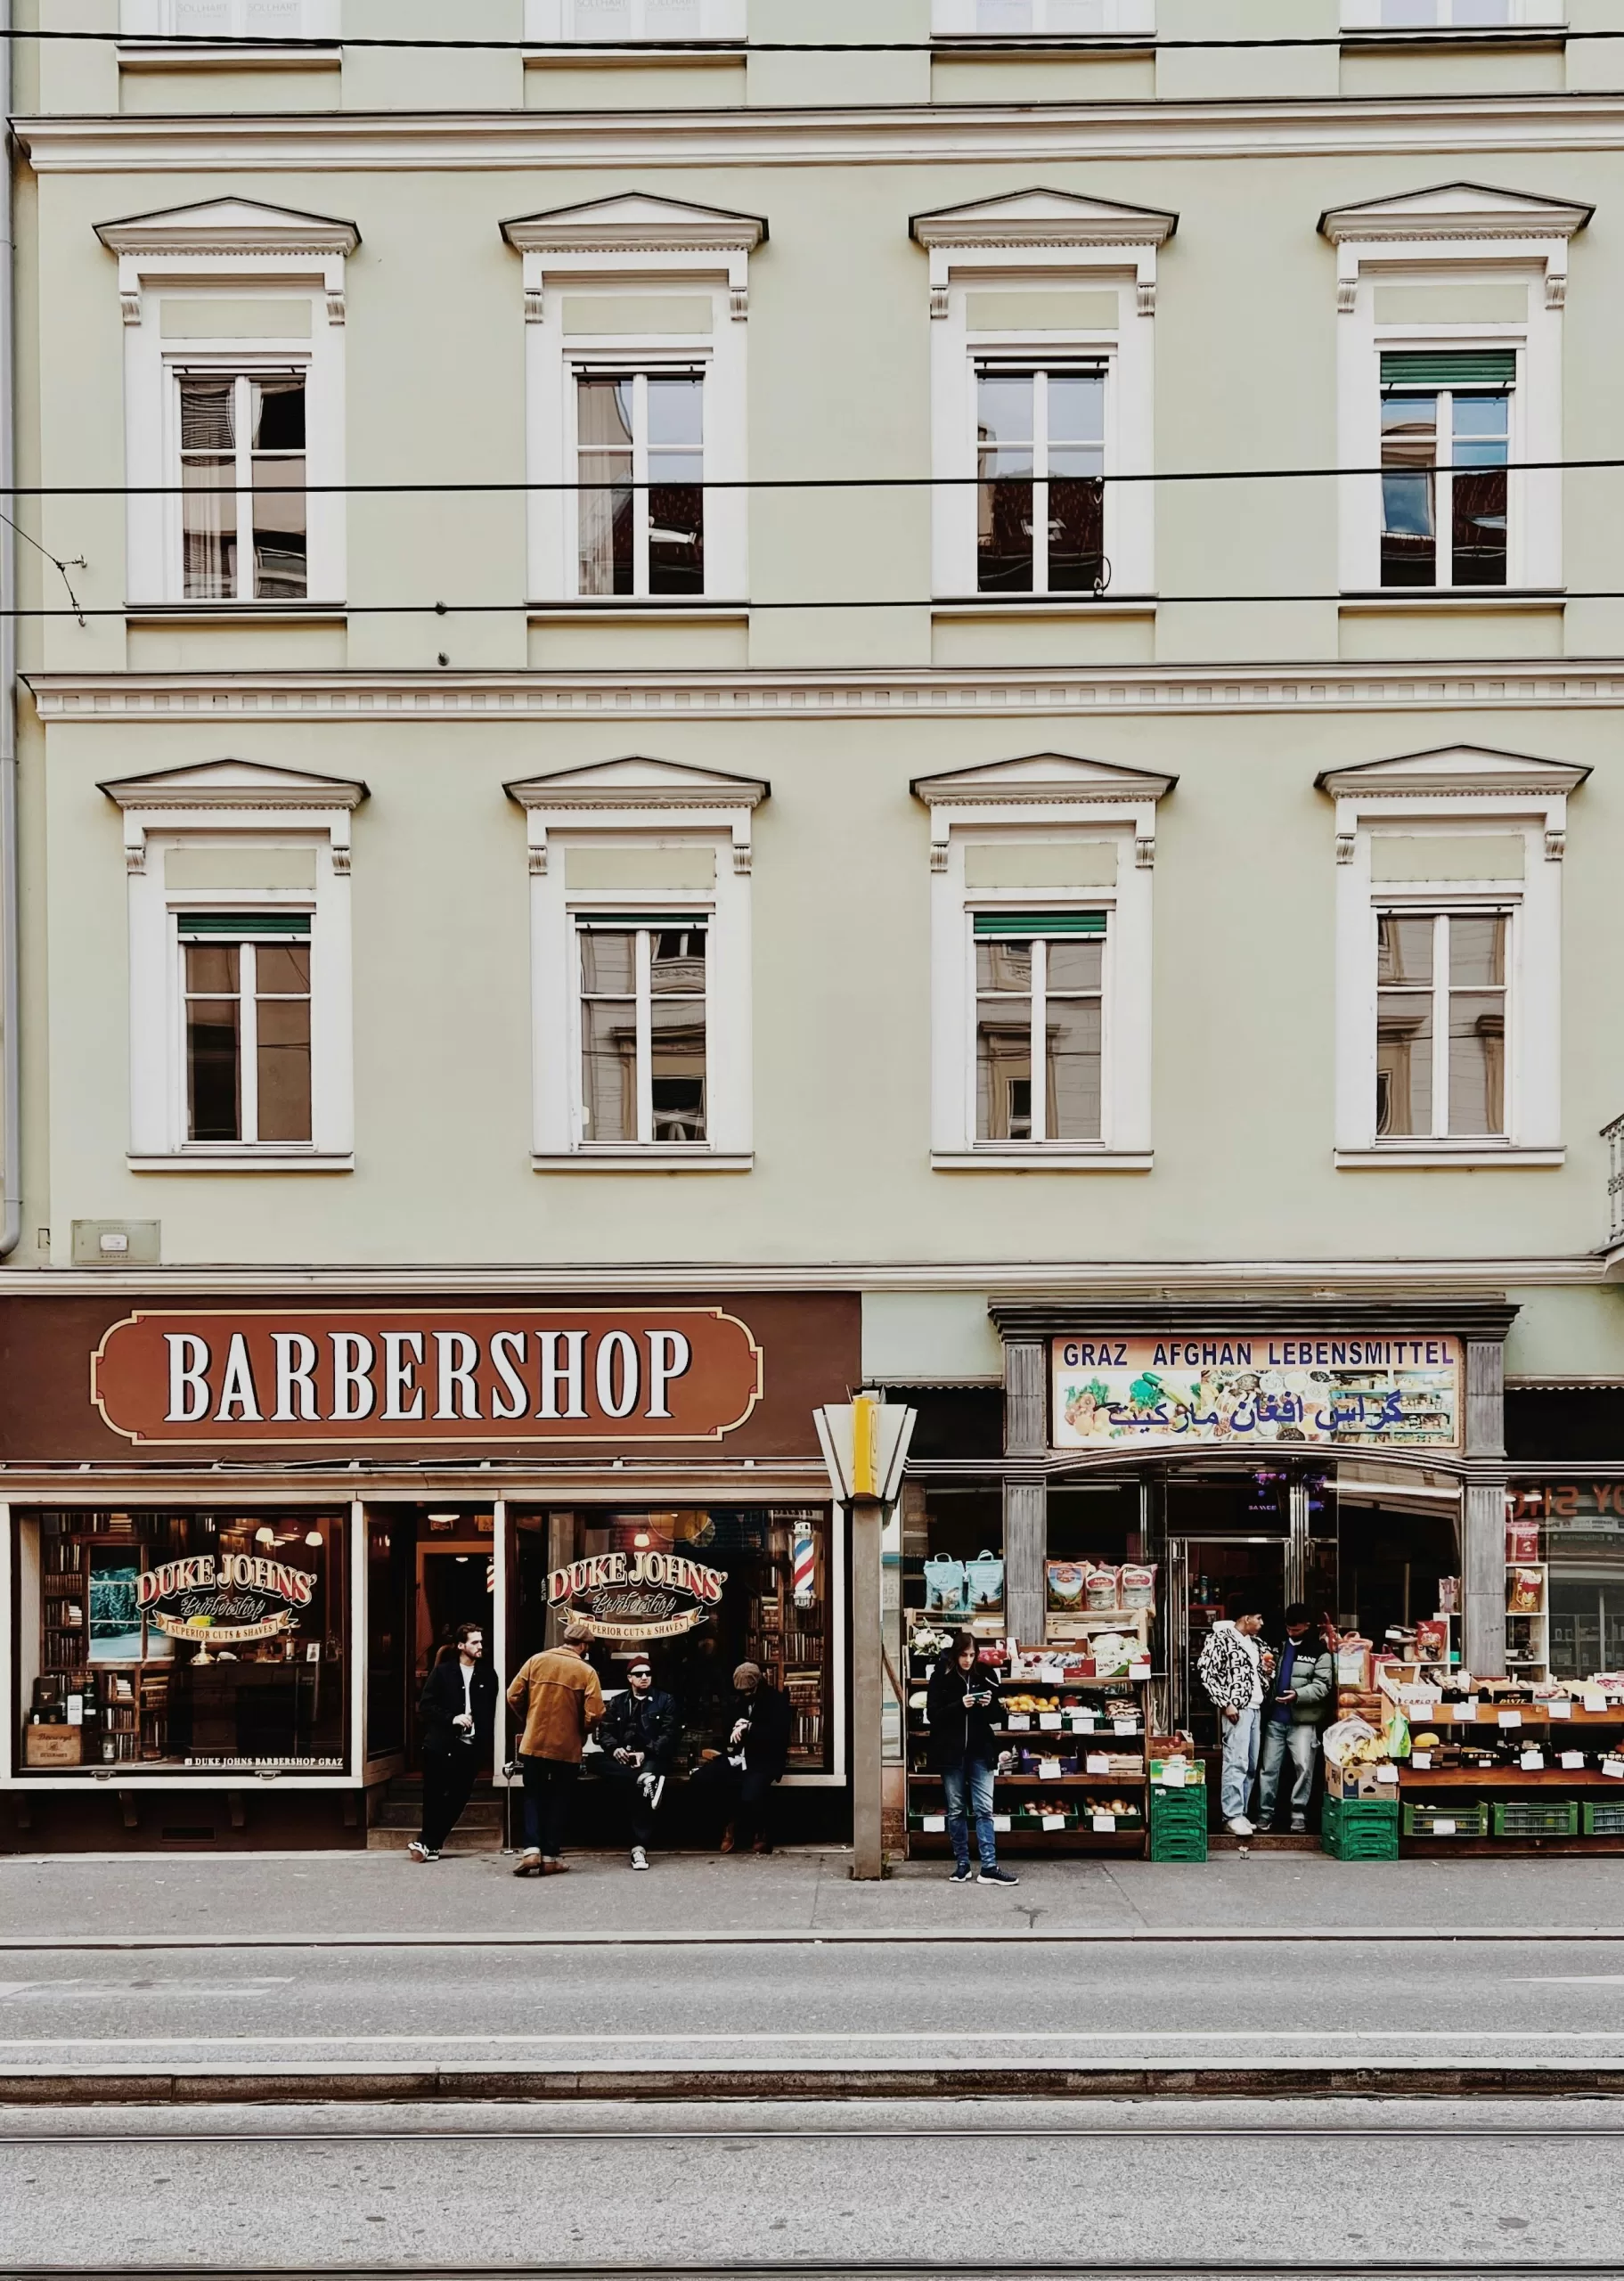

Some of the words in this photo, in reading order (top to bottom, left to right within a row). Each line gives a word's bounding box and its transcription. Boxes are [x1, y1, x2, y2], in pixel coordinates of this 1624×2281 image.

[1064, 1343, 1128, 1366] GRAZ
[1153, 1342, 1252, 1365] AFGHAN
[1269, 1341, 1455, 1365] LEBENSMITTEL
[163, 1330, 690, 1422] BARBERSHOP
[1229, 1391, 1303, 1432] افغان
[136, 1555, 216, 1611] DUKE
[547, 1552, 627, 1608] DUKE
[181, 1594, 265, 1622] Barbershop
[592, 1591, 677, 1619] Barbershop
[171, 1626, 210, 1639] SUPERIOR
[213, 1630, 233, 1639] CUTS
[235, 1631, 241, 1639] &
[243, 1625, 273, 1638] SHAVES
[624, 1629, 644, 1637] CUTS
[655, 1623, 683, 1634] SHAVES
[195, 1758, 220, 1766] DUKE
[223, 1758, 252, 1768] JOHNS
[255, 1758, 314, 1766] BARBERSHOP
[318, 1758, 343, 1766] GRAZ
